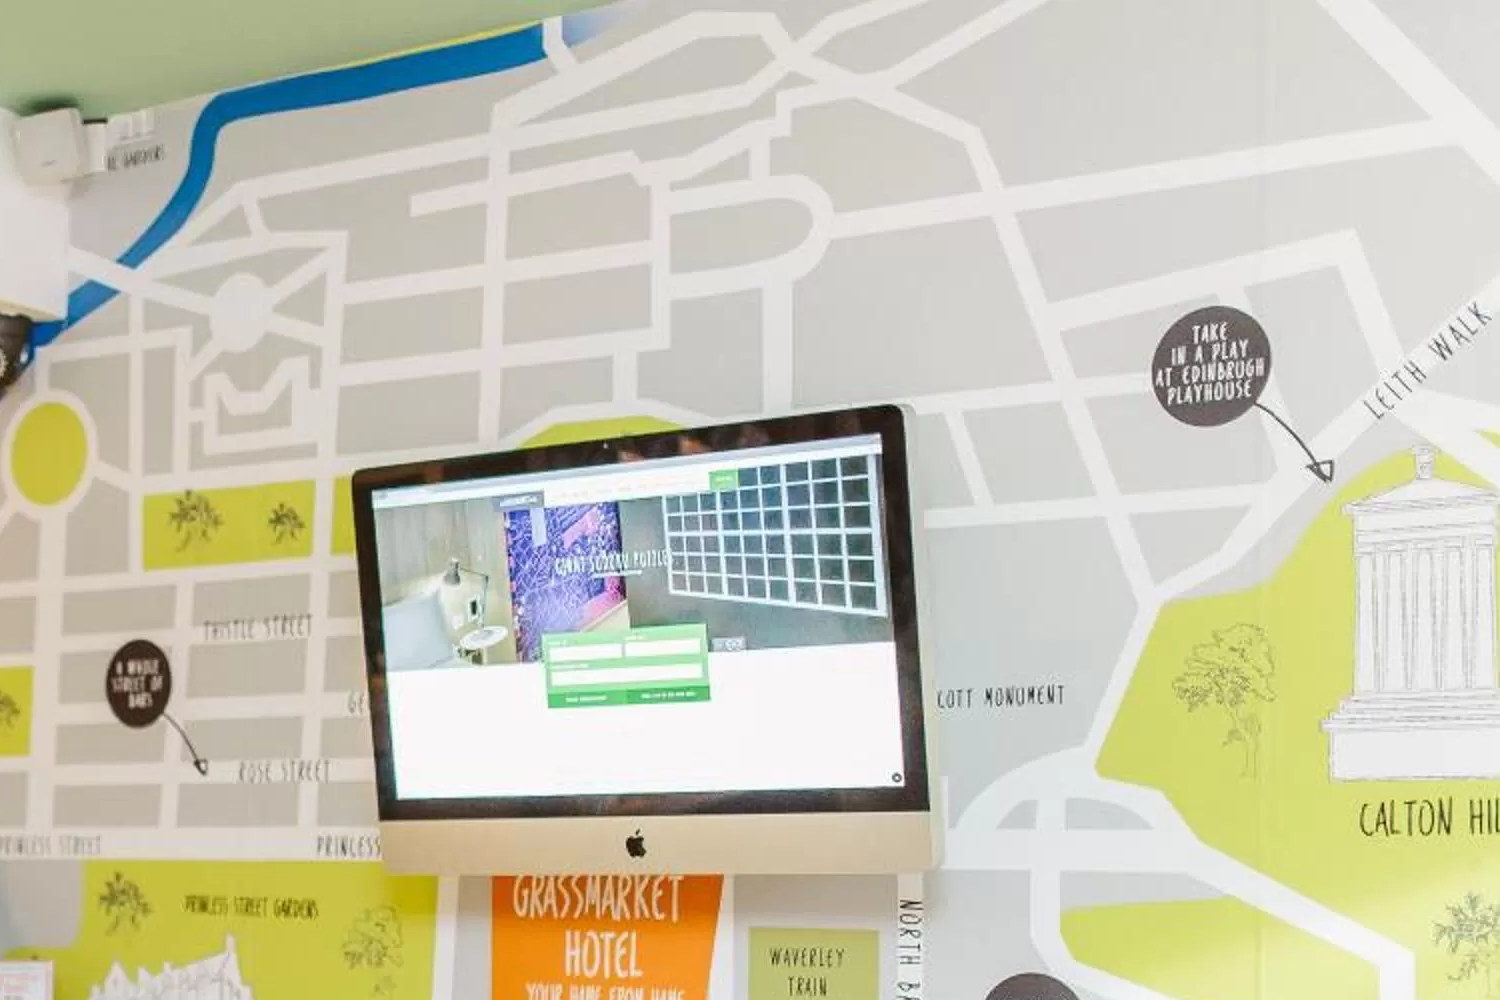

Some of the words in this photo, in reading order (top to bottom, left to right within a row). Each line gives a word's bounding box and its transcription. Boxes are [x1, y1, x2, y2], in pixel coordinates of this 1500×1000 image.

[1192, 321, 1228, 344] TAKE
[1171, 345, 1186, 366] IN
[1195, 345, 1203, 363] A
[1212, 339, 1248, 360] PLAY
[1363, 360, 1427, 419] LEITH
[1428, 301, 1492, 361] WALK
[1155, 367, 1172, 387] AT
[1167, 380, 1252, 406] PLAYHOUSE
[263, 613, 312, 637] STREET
[984, 684, 1064, 708] MONUMENT
[238, 760, 272, 784] ROSE
[281, 758, 330, 784] STREET
[1360, 796, 1452, 837] CALTON
[316, 835, 381, 858] PRINCESS
[513, 874, 684, 923] GRASSMARKET
[897, 899, 924, 965] NORTH
[564, 929, 643, 979] HOTEL
[769, 946, 845, 968] WAVERLEY
[788, 976, 827, 996] TRAIN
